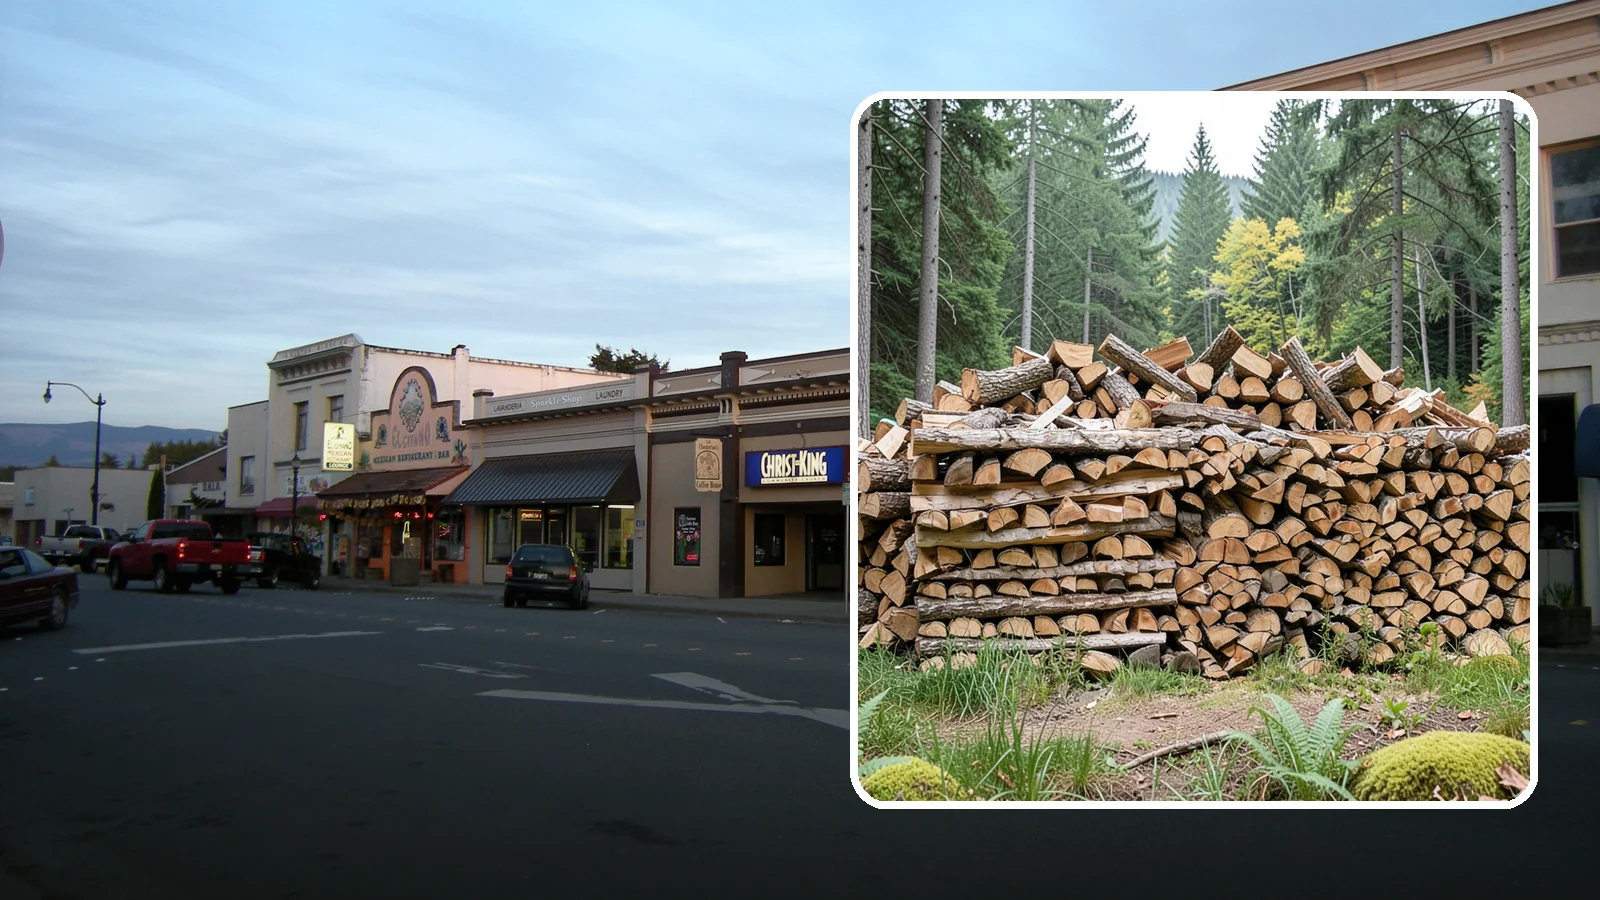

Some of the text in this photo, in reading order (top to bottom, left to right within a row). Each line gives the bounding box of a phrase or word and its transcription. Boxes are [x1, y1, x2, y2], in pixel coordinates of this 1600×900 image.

[595, 389, 624, 400] LAUNDRY
[493, 402, 523, 412] LAVANDERIA
[373, 450, 450, 464] MEXICAN RESTAURANT BAR
